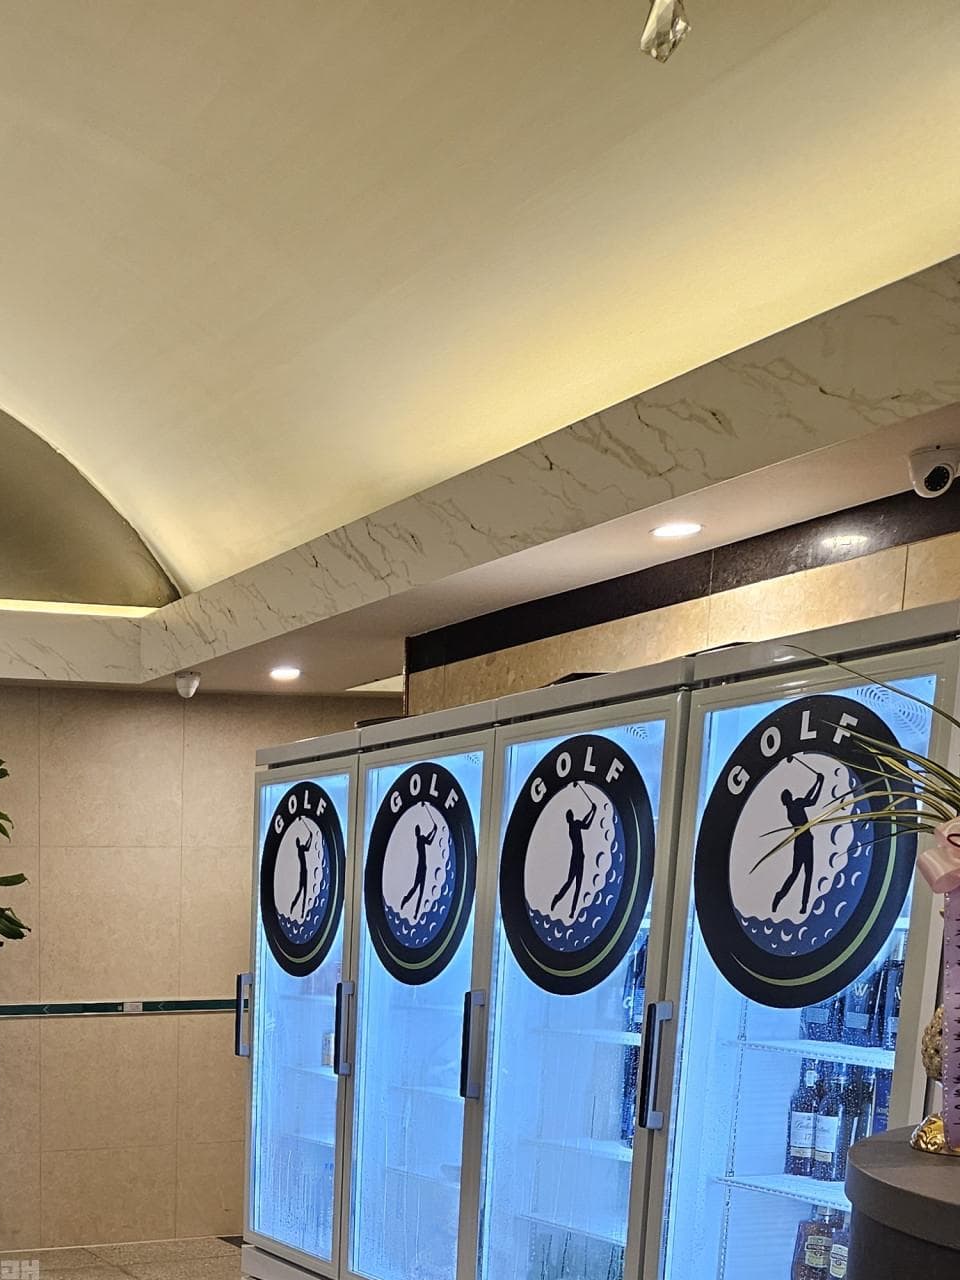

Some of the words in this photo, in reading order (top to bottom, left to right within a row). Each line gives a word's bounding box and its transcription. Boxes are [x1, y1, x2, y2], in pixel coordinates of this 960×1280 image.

[529, 747, 624, 803] GOLF
[727, 710, 859, 795] GOLF
[274, 790, 327, 834] GOLF
[390, 772, 459, 813] GOLF
